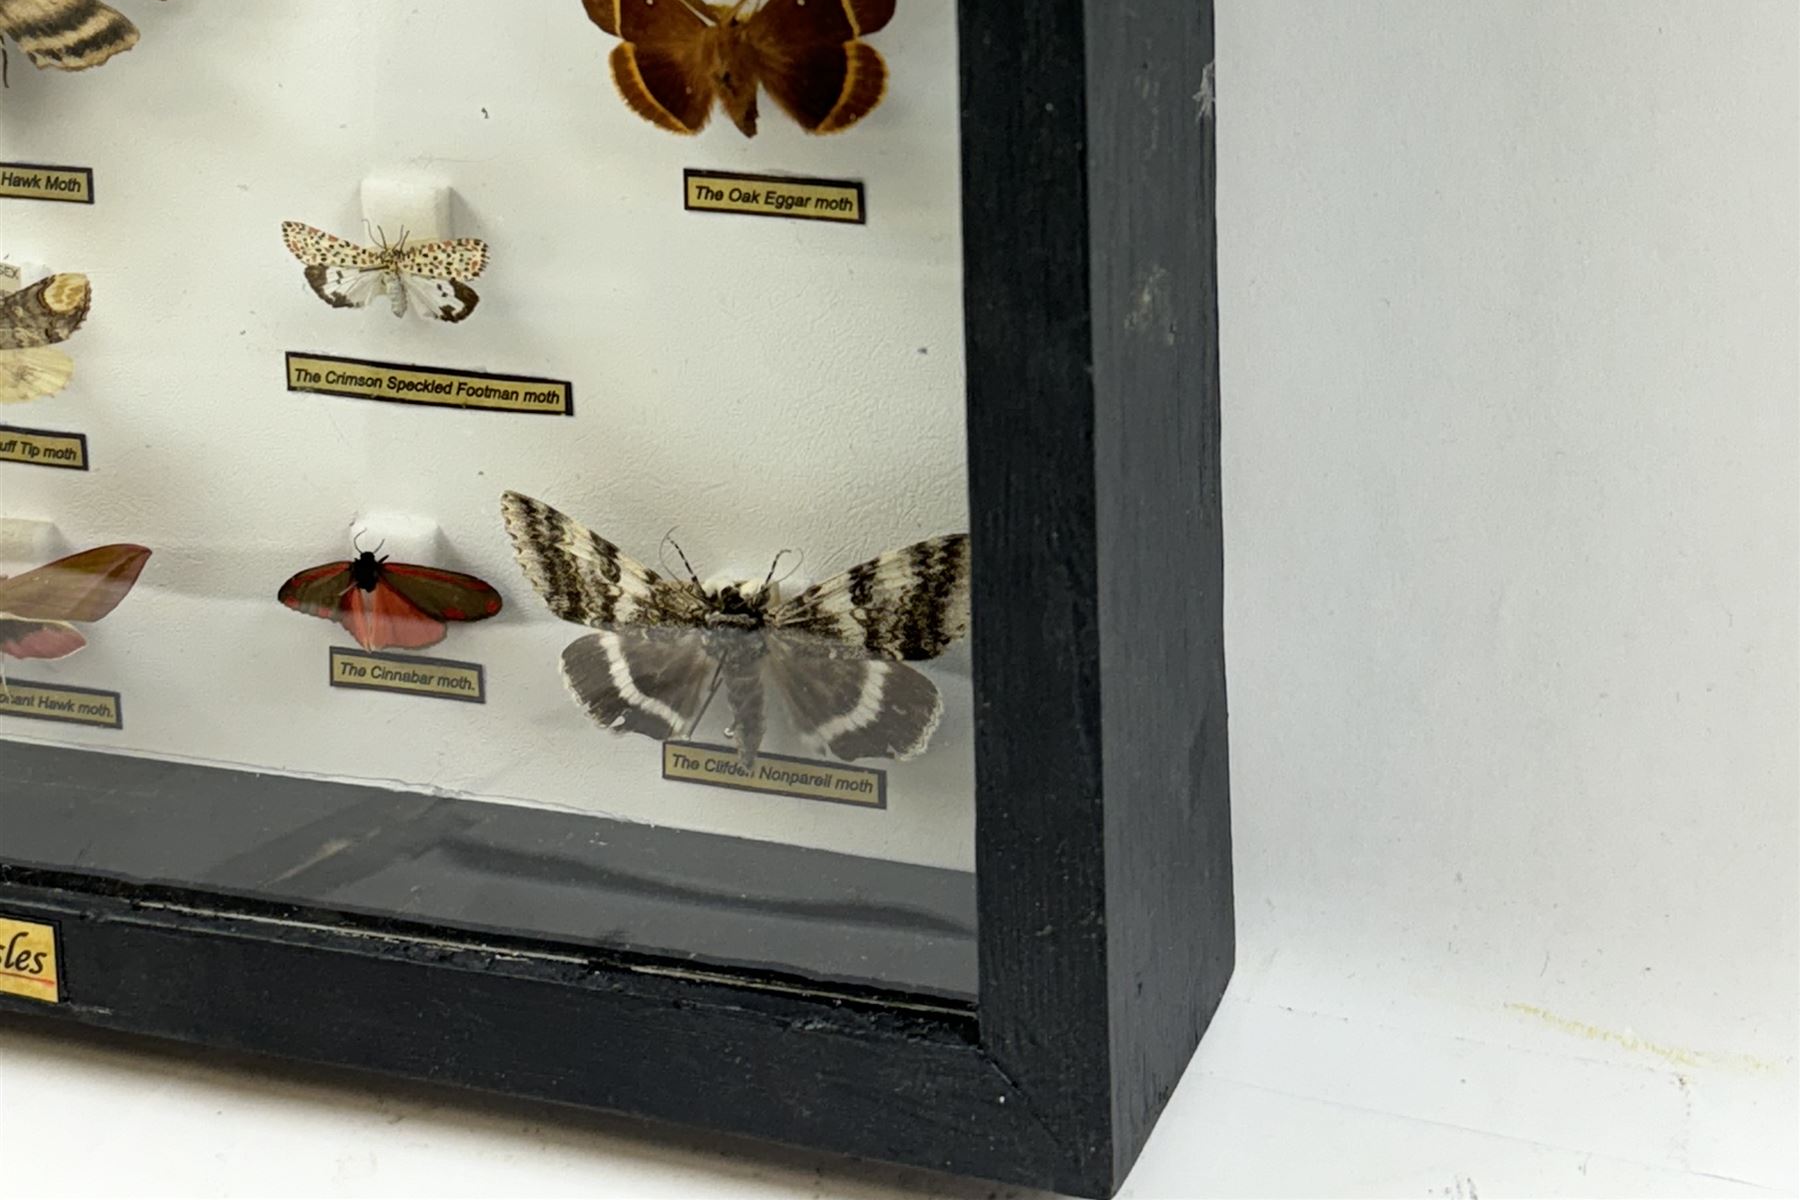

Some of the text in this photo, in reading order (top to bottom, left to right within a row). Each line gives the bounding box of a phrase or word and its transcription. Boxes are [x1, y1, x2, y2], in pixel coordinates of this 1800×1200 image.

[1, 171, 81, 192] Hawk Moth
[695, 185, 853, 212] The Oak Eggar moth
[294, 368, 560, 404] The Crimson Speckled Footman moth
[20, 441, 40, 458] Tip
[43, 447, 77, 461] moth
[340, 661, 475, 691] The Cinnabar moth.
[38, 695, 74, 712] Hawk
[78, 703, 114, 719] moth.
[672, 753, 700, 770] The
[759, 766, 832, 788] Nonpareil
[835, 778, 874, 793] moth
